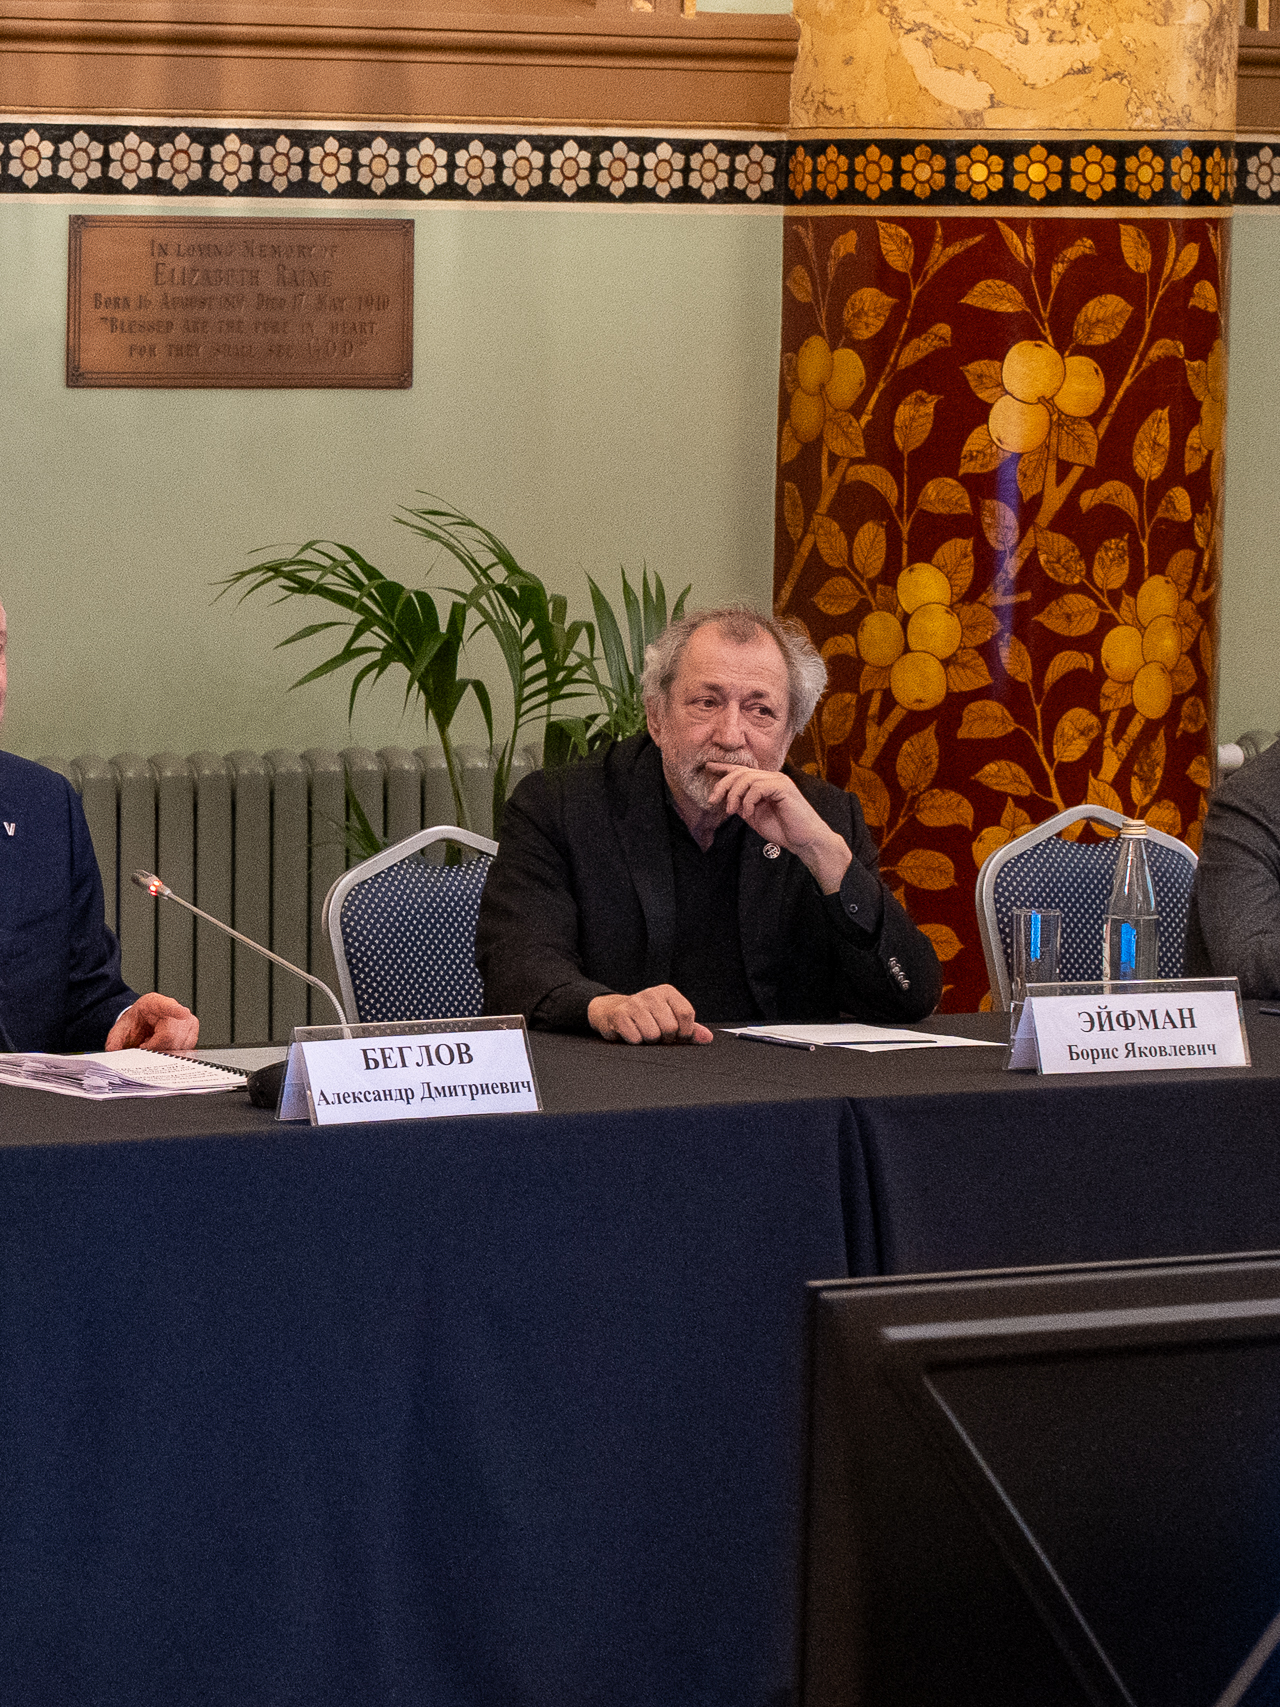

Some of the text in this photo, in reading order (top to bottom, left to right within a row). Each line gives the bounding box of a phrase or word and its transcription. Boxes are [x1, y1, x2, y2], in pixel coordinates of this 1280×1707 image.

[1077, 1005, 1198, 1033] ЭЙФМАН
[359, 1042, 474, 1071] БЕГЛОВ
[1066, 1041, 1217, 1064] Борис Яковлевич
[317, 1079, 532, 1106] Александр Дмитриевич
